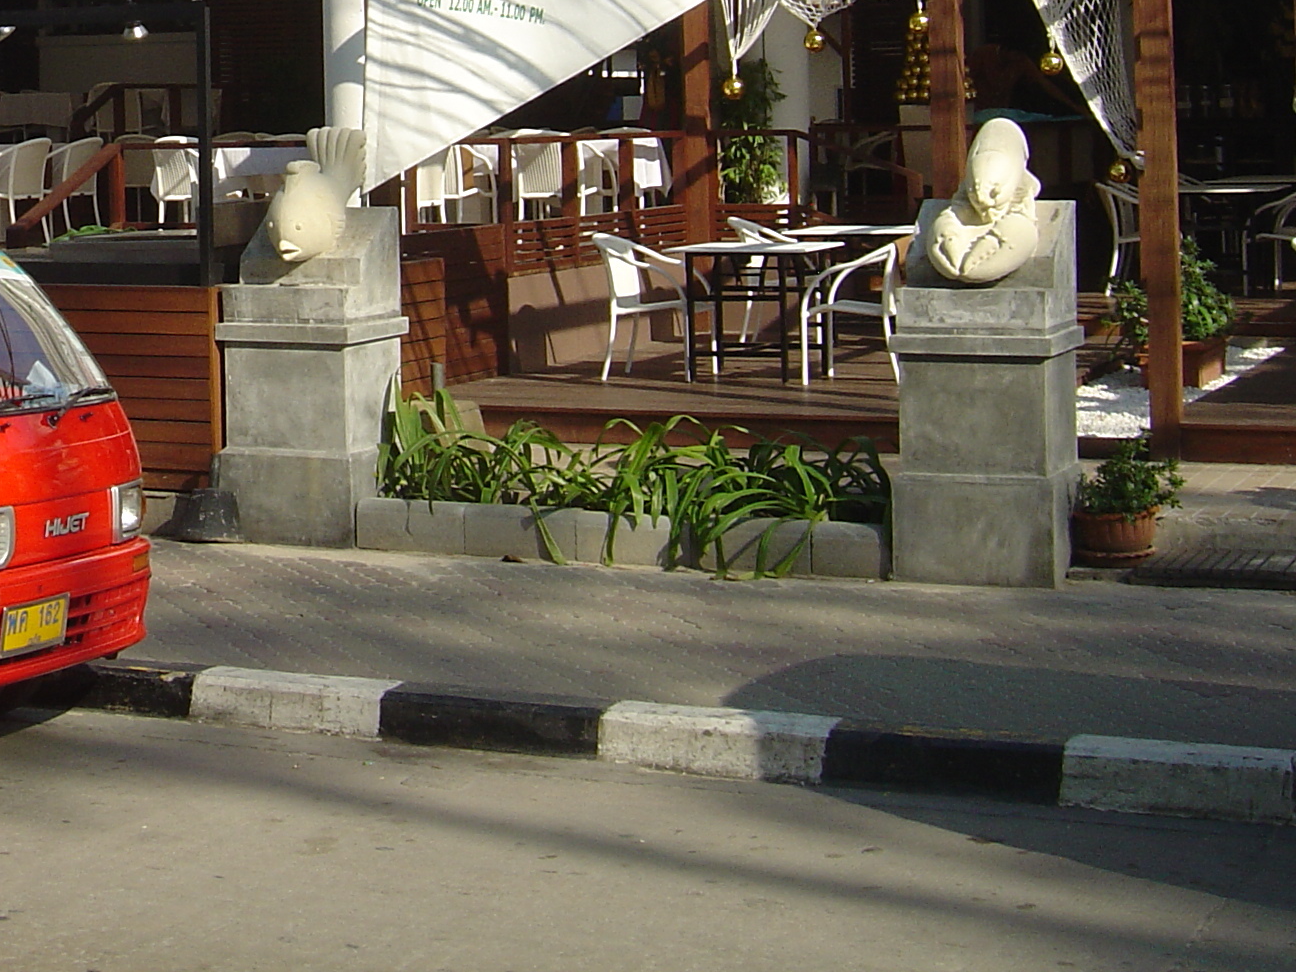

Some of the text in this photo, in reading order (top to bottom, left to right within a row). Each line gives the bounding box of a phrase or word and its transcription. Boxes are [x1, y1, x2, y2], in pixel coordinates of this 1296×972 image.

[500, 1, 526, 21] 11.00
[44, 512, 90, 538] HIJET
[39, 601, 61, 628] 162
